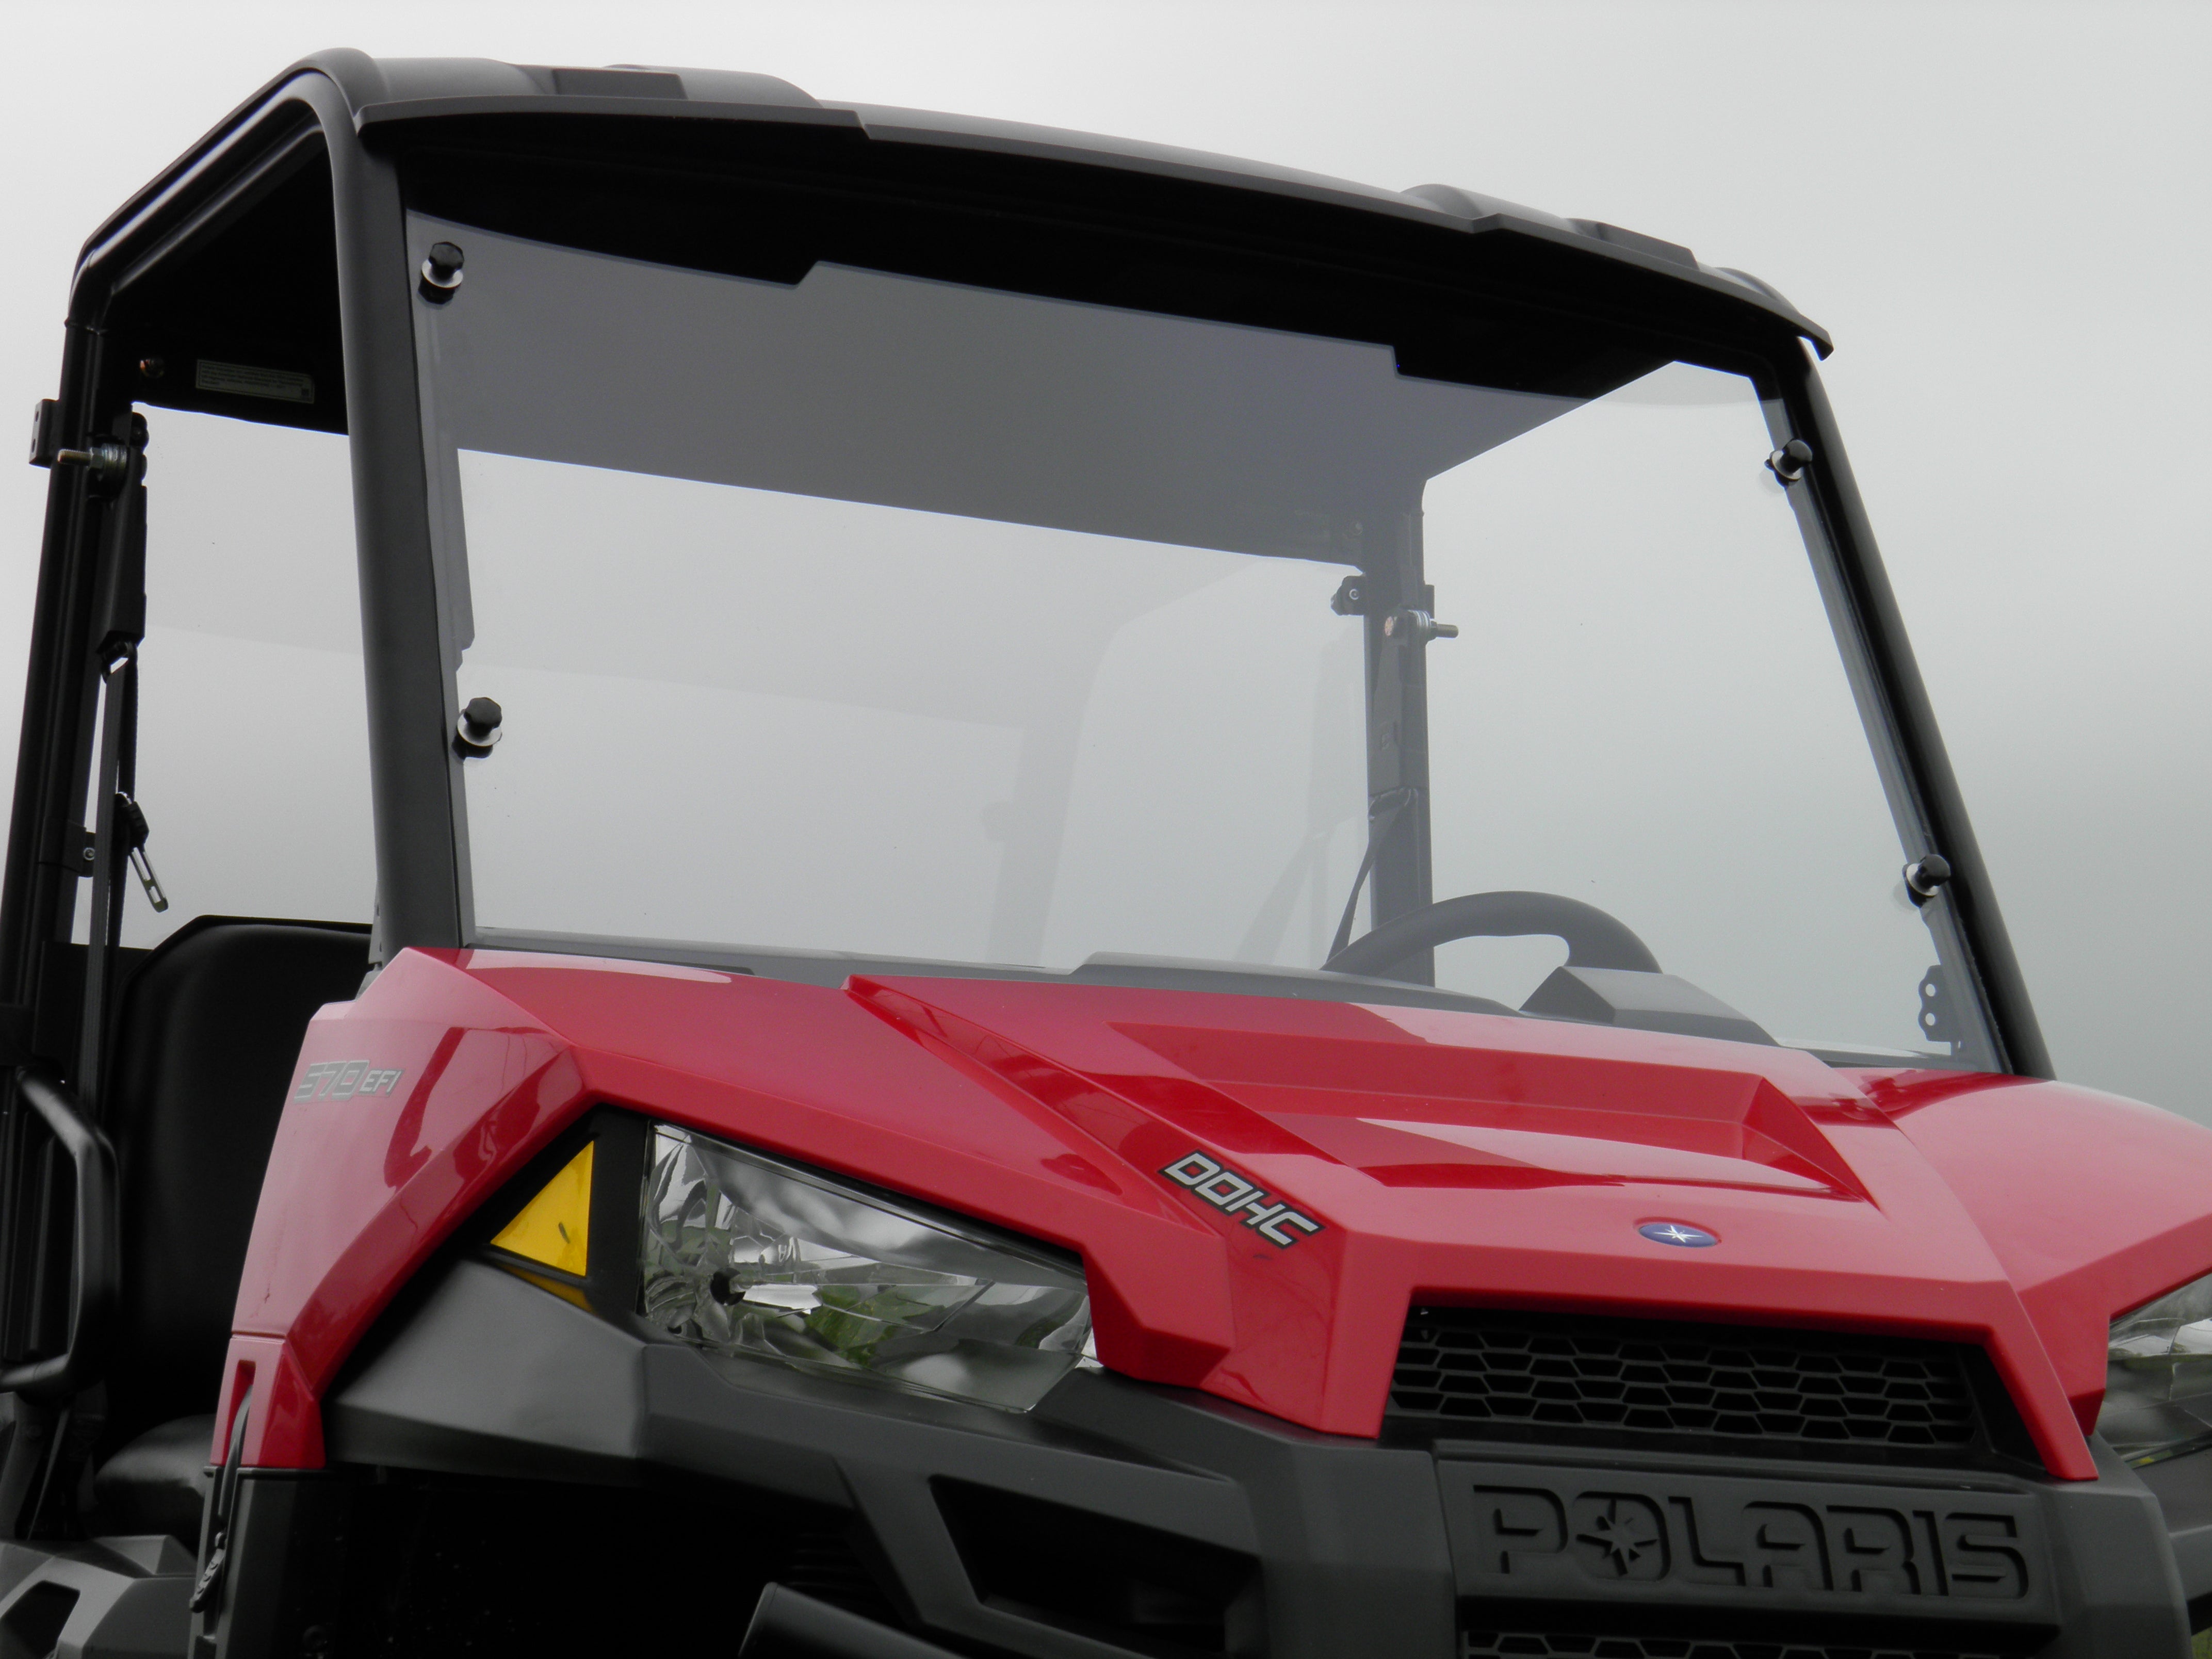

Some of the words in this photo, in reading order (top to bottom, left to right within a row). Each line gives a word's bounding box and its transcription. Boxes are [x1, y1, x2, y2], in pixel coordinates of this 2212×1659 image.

[294, 1060, 370, 1103] 570
[359, 1069, 405, 1097] EFI
[1160, 1149, 1324, 1248] DOHC
[1473, 1484, 2030, 1600] POLARIS
